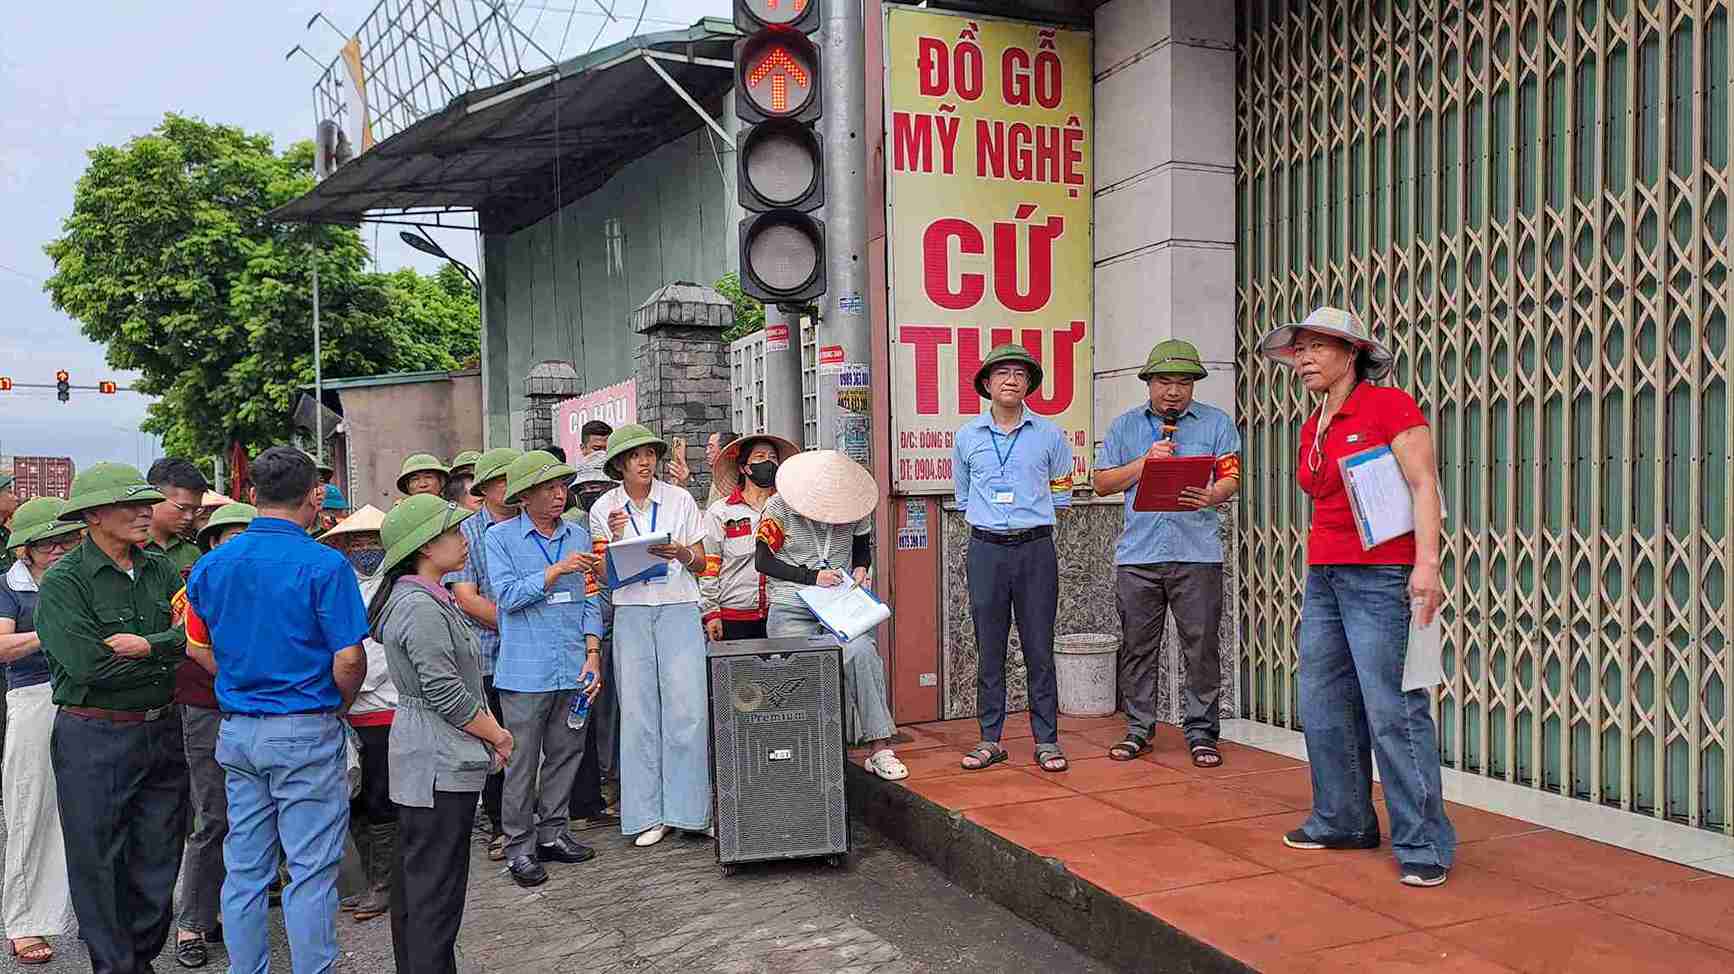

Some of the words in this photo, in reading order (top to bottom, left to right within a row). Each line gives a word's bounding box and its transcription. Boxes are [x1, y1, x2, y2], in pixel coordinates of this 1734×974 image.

[917, 22, 984, 101] ĐỒ
[1002, 29, 1063, 109] GỖ
[893, 104, 961, 175] MỸ
[976, 116, 1084, 198] NGHỆ
[923, 204, 1064, 312] CỨ
